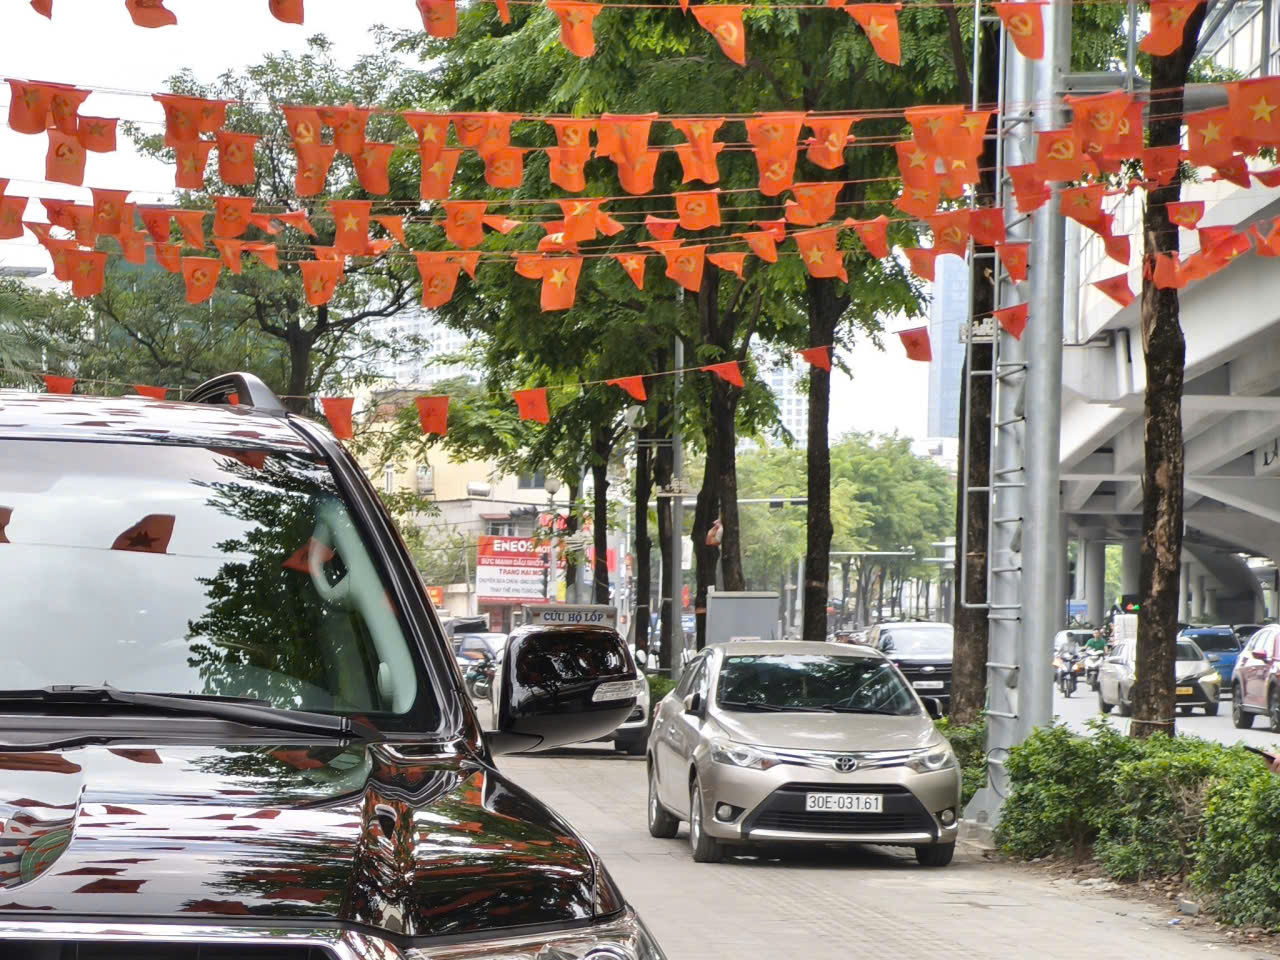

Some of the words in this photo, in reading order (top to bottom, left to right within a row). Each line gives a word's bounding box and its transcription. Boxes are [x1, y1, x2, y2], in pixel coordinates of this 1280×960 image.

[493, 539, 535, 553] ENEOS
[567, 610, 582, 624] HỘ
[584, 609, 604, 623] LỐP
[808, 795, 880, 811] 30E-031.61
